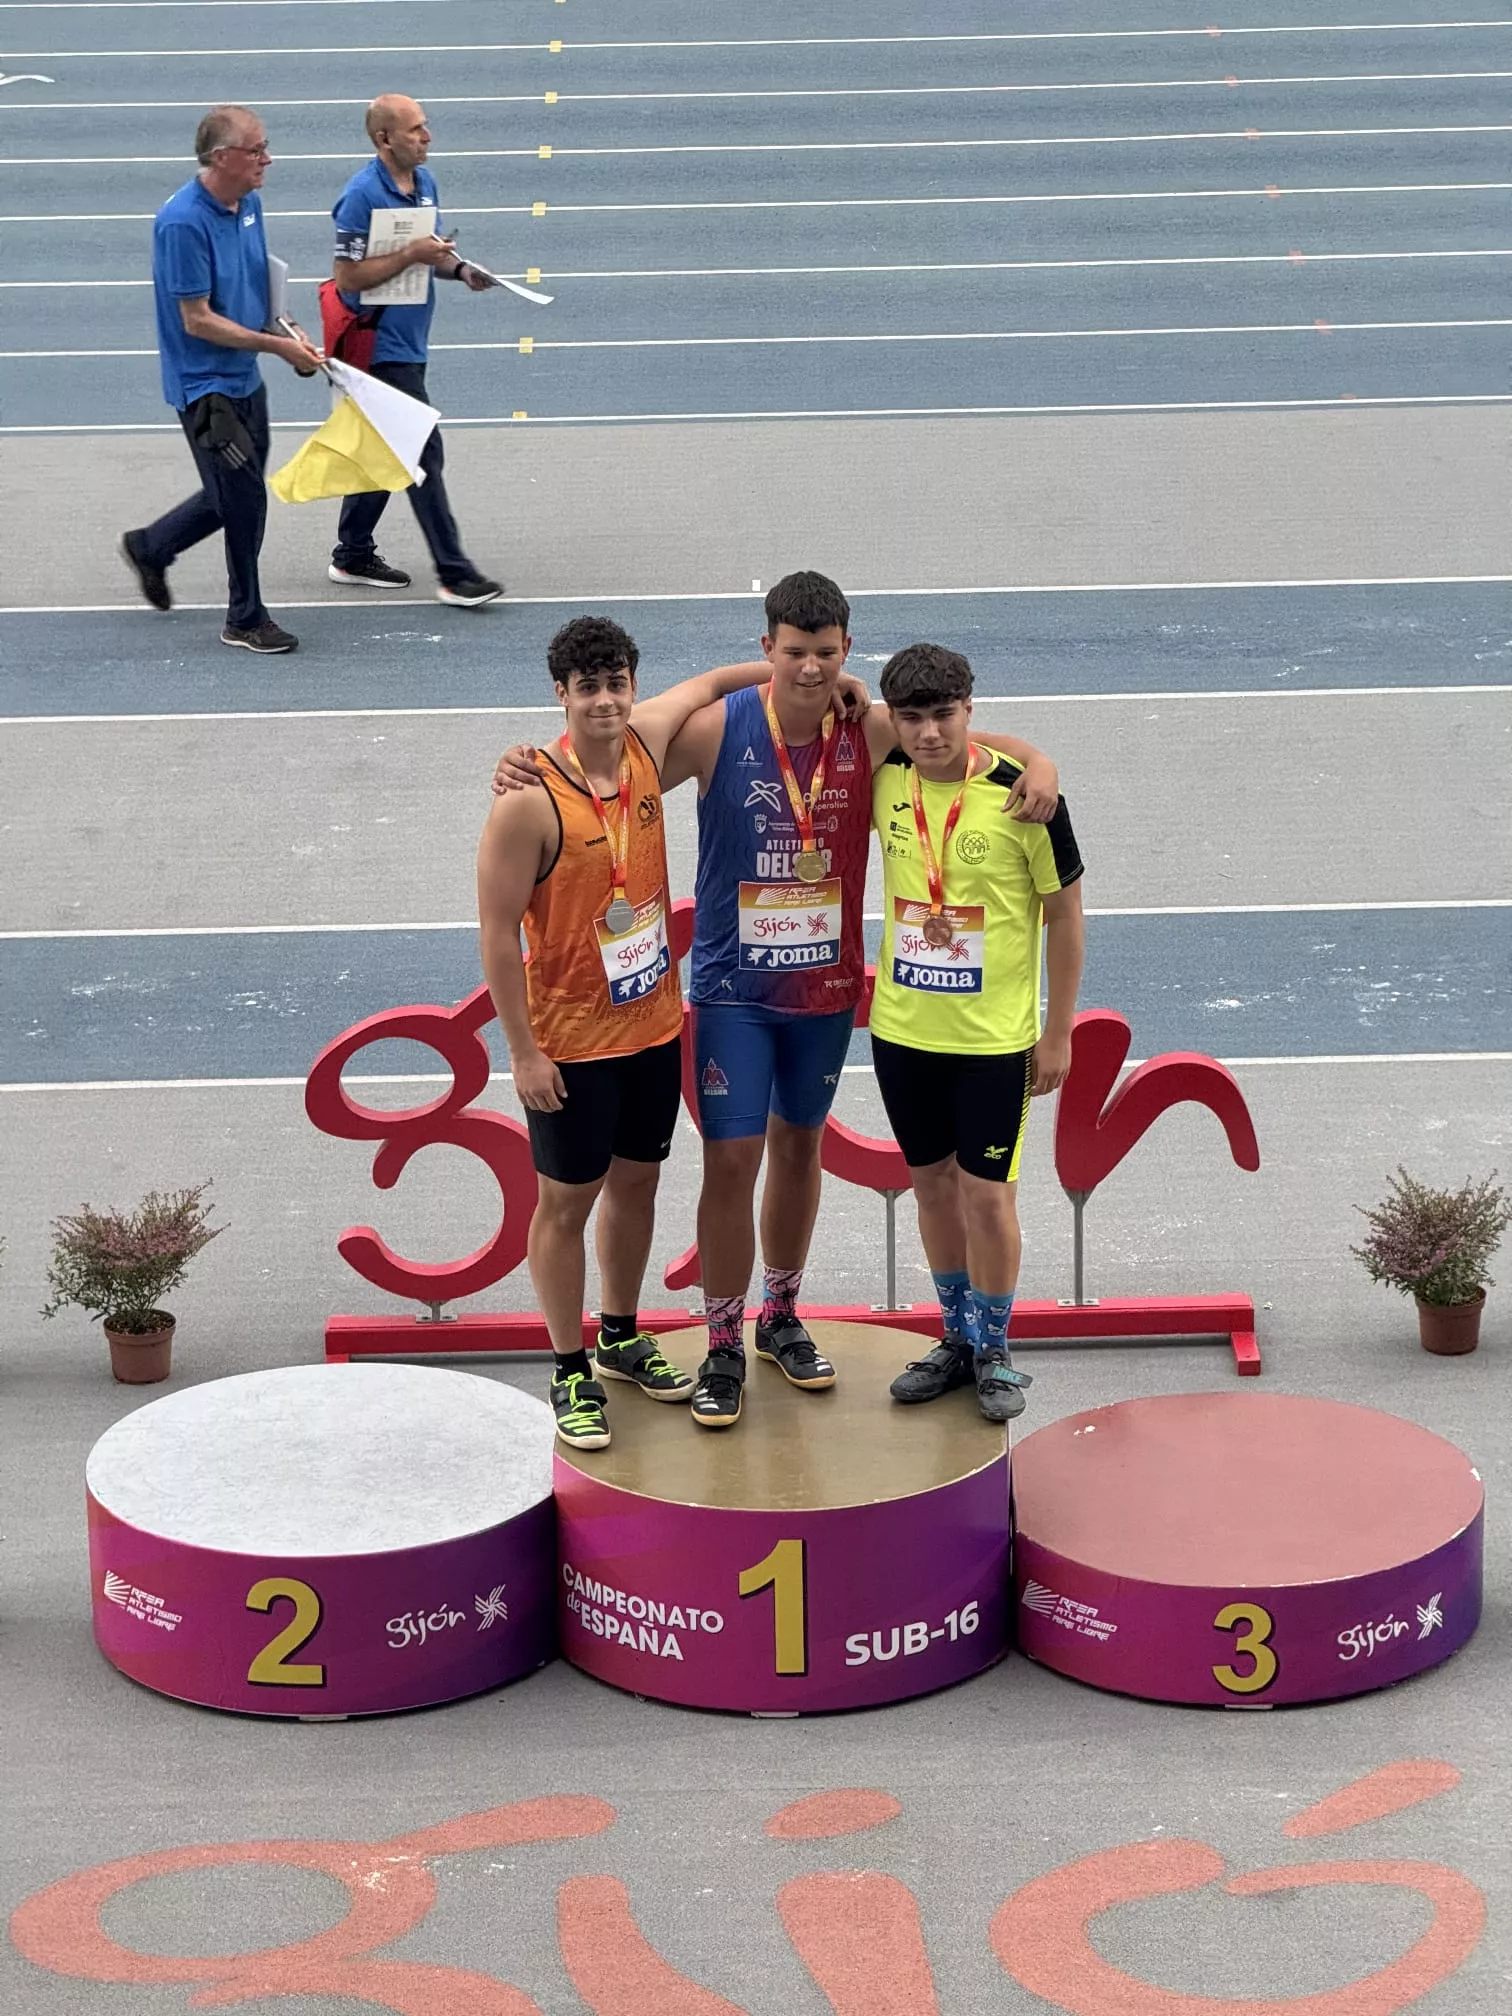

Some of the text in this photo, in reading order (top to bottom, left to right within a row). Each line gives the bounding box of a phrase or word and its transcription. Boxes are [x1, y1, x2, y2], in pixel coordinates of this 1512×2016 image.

[753, 916, 802, 939] gijón
[992, 1366, 1024, 1385] NIKE
[386, 1603, 466, 1648] gijón
[563, 1563, 724, 1634] CAMPEONATO
[567, 1591, 685, 1661] de ESPAÑA
[739, 1539, 808, 1676] 1
[1056, 1607, 1118, 1633] ATLETISMO
[246, 1577, 327, 1687] 2
[845, 1600, 980, 1666] SUB-16
[1213, 1602, 1280, 1696] 3
[1338, 1613, 1409, 1661] gijón
